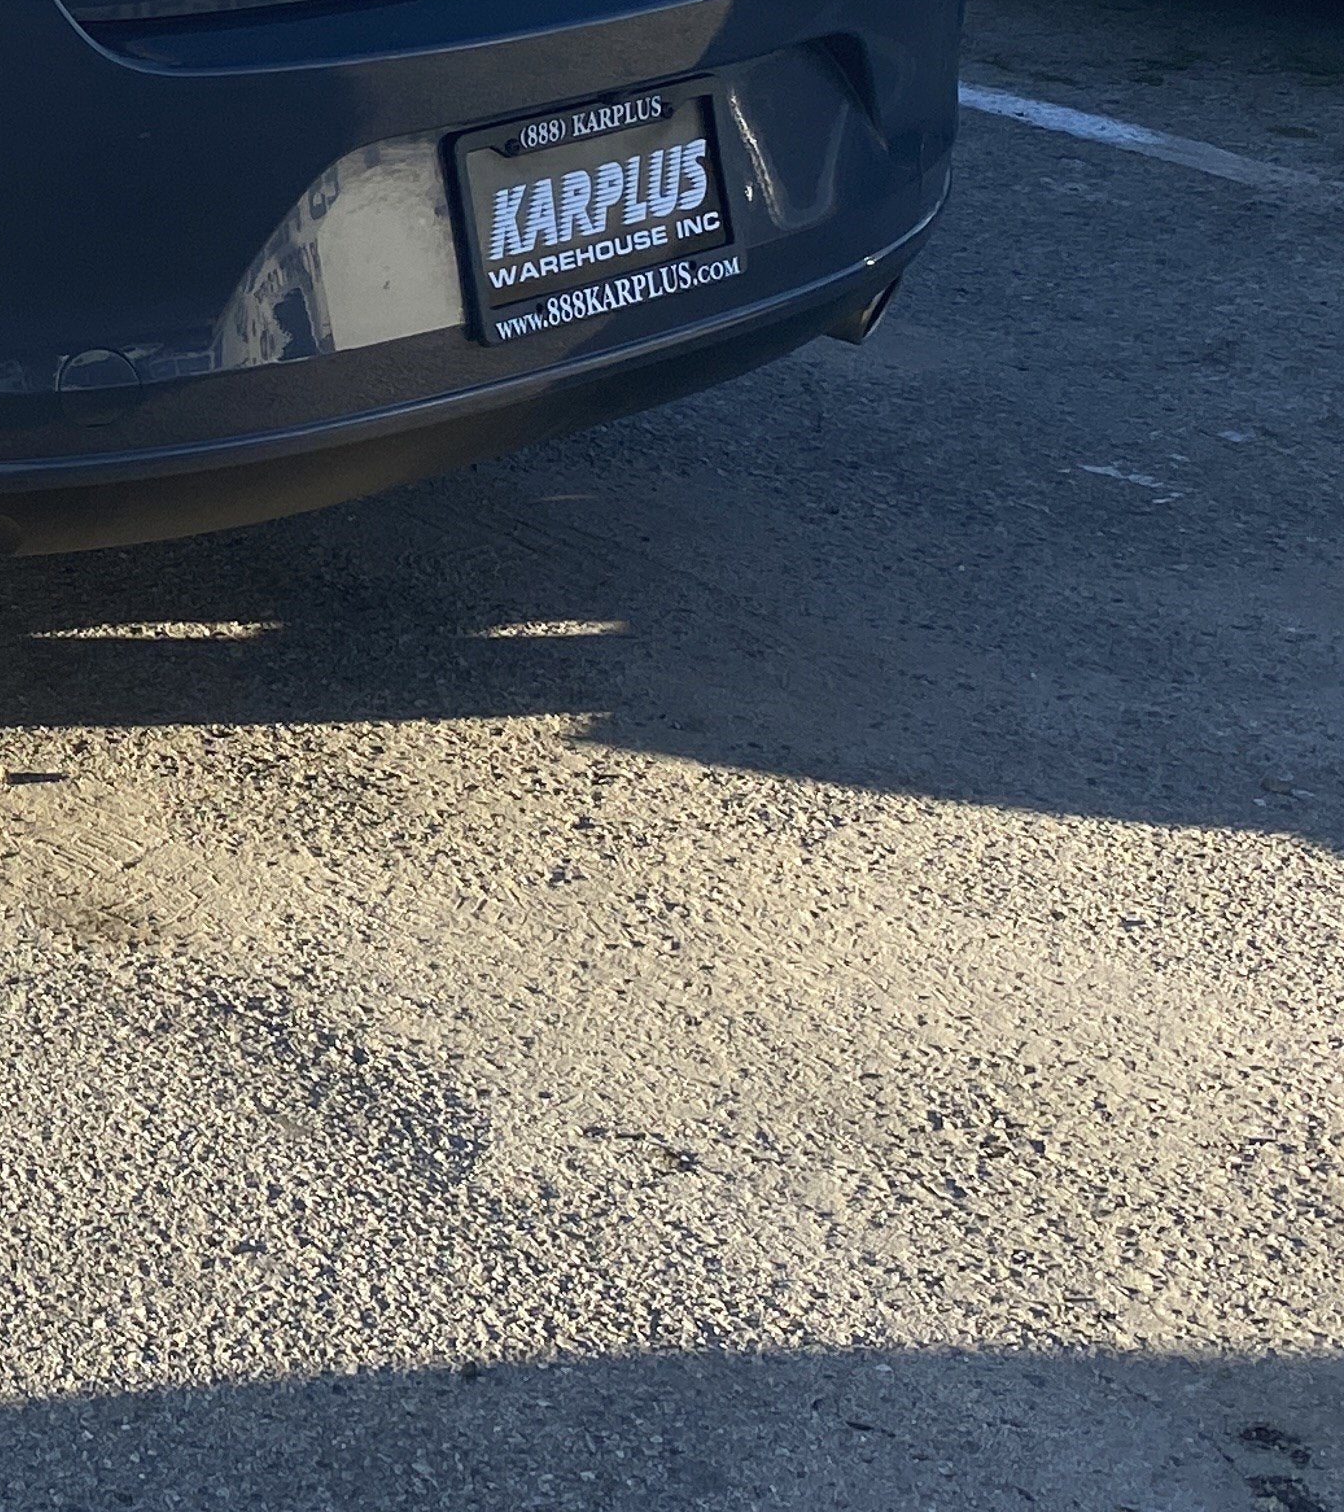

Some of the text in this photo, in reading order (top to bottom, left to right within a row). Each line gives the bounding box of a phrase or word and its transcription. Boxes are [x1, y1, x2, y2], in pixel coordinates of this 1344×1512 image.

[519, 95, 662, 149] (888) KARPLUS
[488, 138, 708, 261] KARPLUS
[488, 211, 721, 289] WAREHOUSE INC
